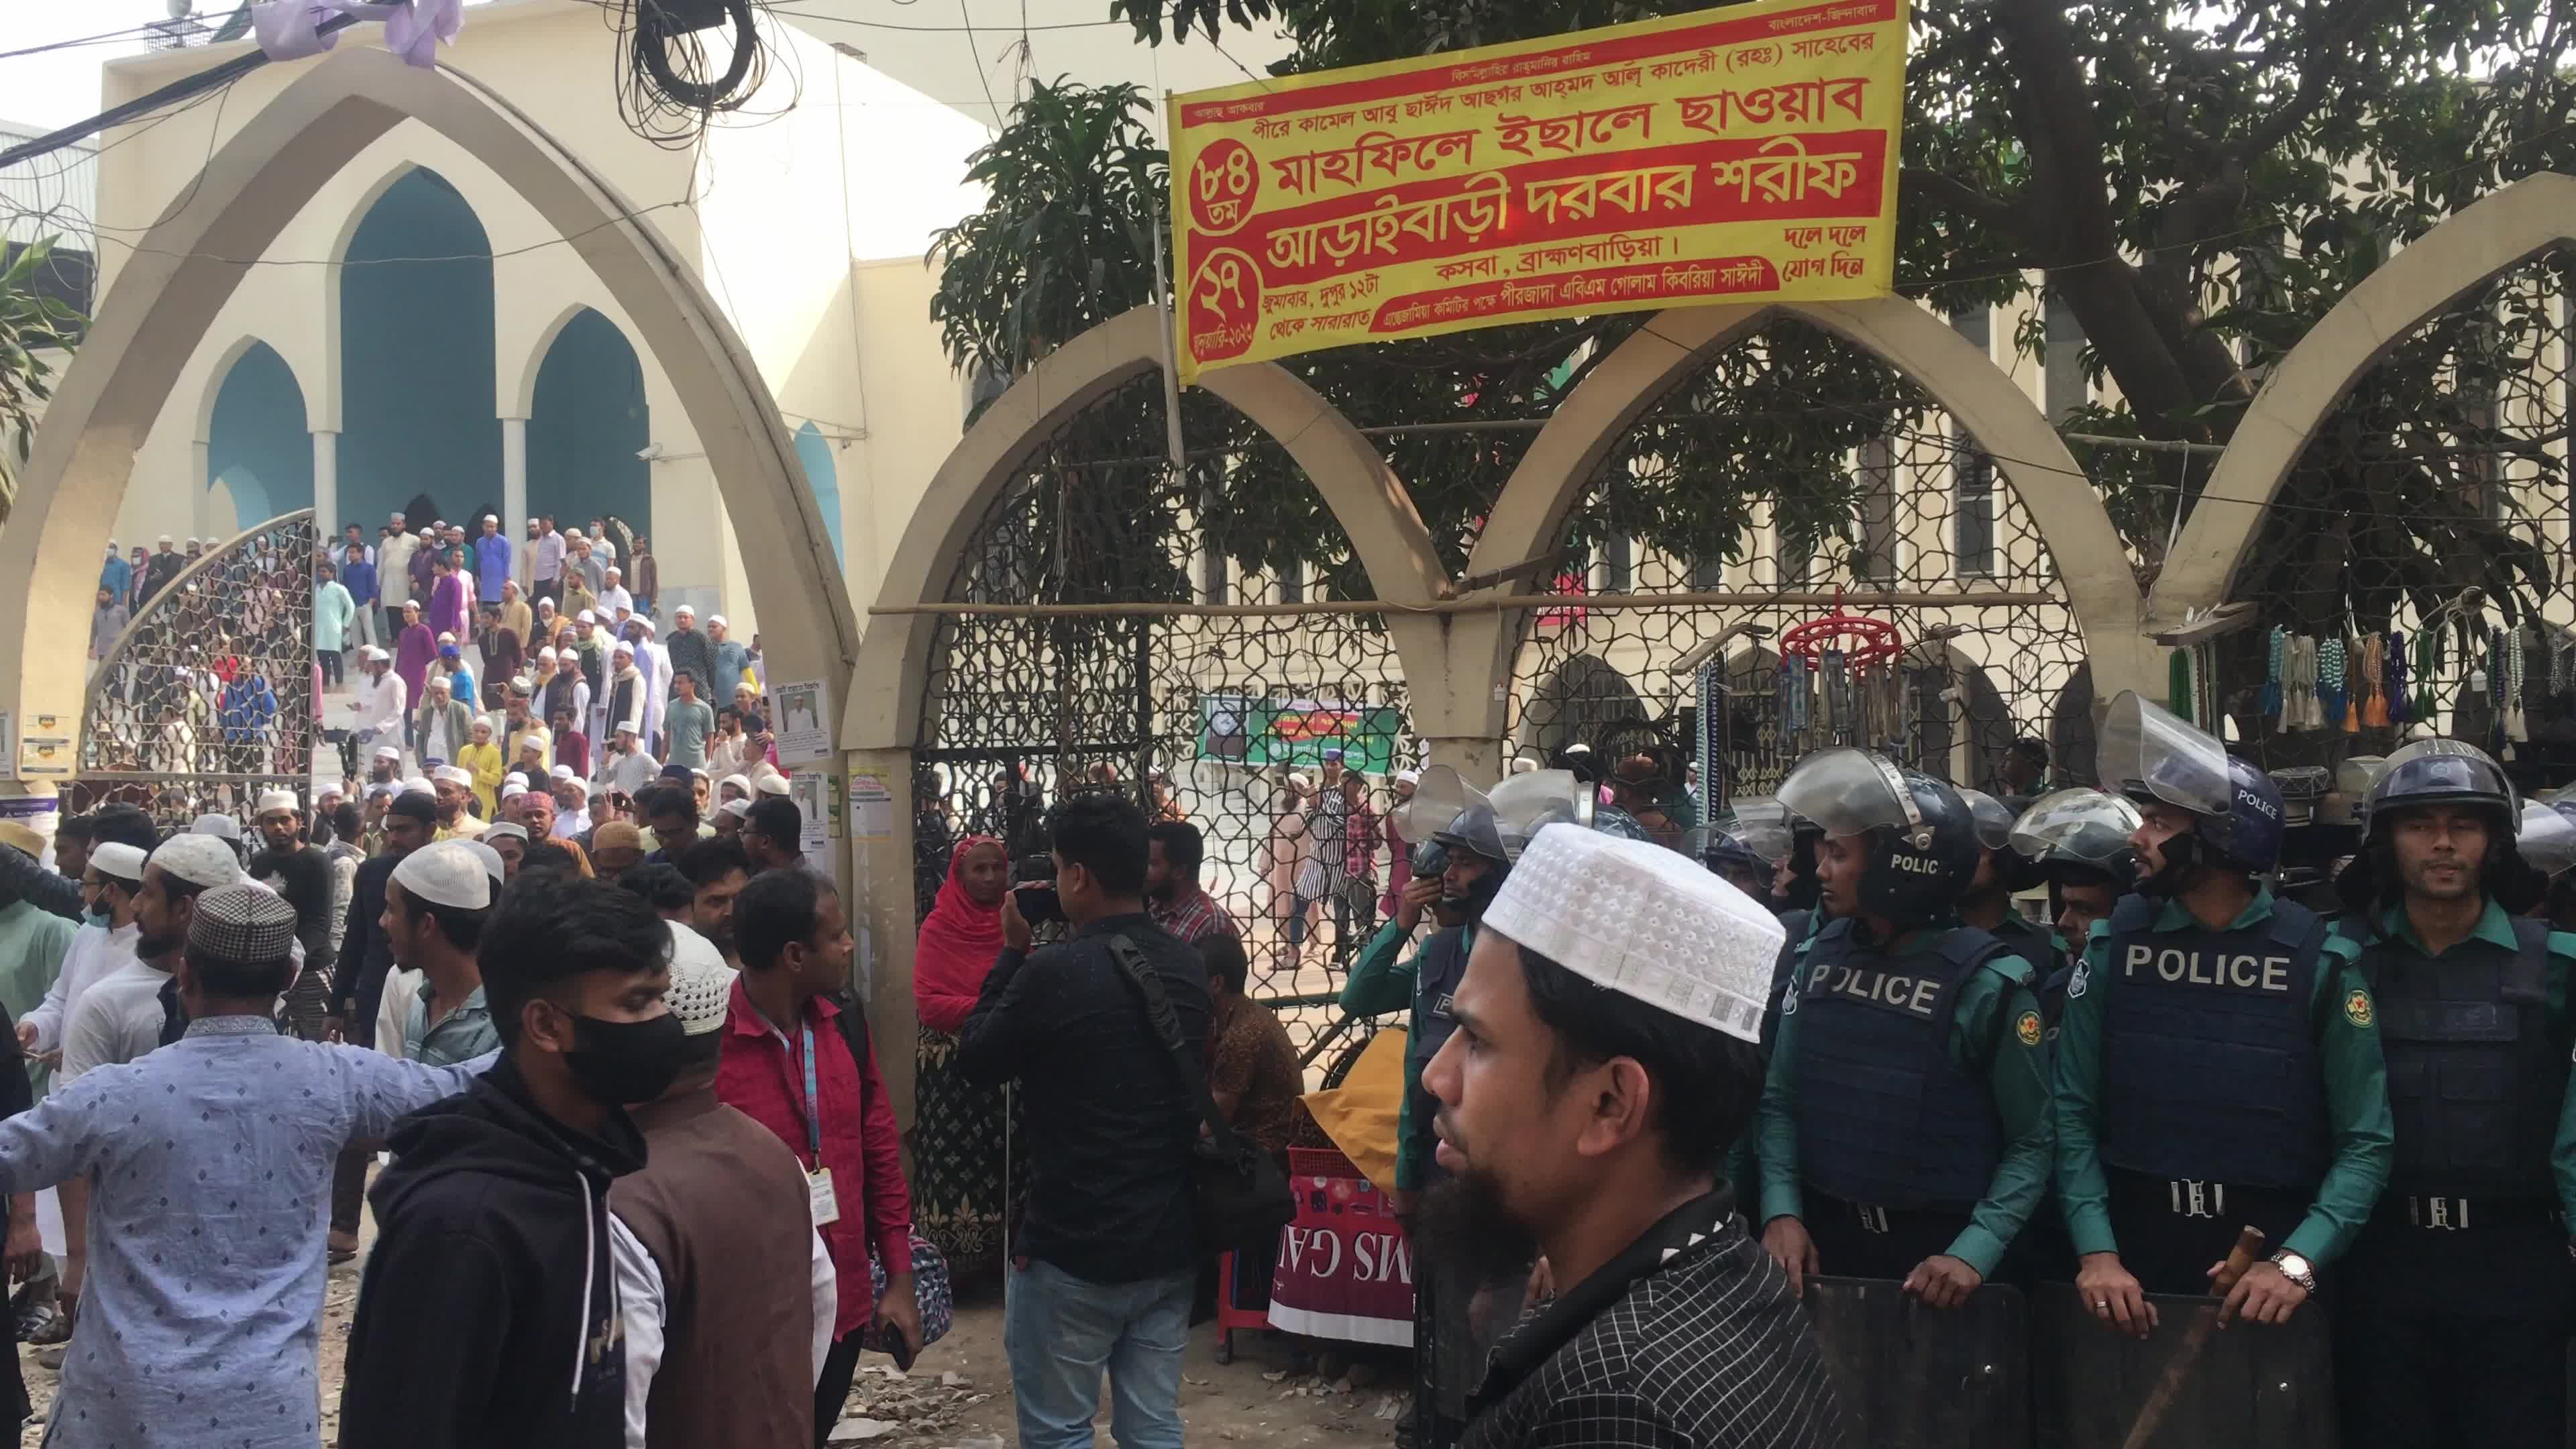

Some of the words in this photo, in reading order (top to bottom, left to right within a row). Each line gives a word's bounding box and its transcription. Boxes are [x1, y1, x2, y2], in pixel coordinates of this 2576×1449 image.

[1252, 118, 1293, 140] পীরে
[1298, 111, 1356, 133] কামেল
[1361, 104, 1399, 124] আবু
[1650, 50, 1719, 78] কাদেরী
[1791, 32, 1876, 58] সাহেবের
[1269, 129, 1481, 196] মাহফিলে
[1493, 102, 1660, 157] ইছালে
[1674, 76, 1872, 134] ছাওয়াব
[1197, 148, 1250, 202] ৮৪
[1205, 197, 1242, 226] তম
[1267, 170, 1512, 269] আড়াইবাড়ী
[1525, 164, 1697, 226] দরবার
[1711, 136, 1864, 204] শরীফ
[1784, 225, 1823, 249] দলে
[1828, 225, 1868, 248] দলে
[1434, 295, 1470, 317] কমিটির
[1472, 294, 1498, 312] পক্ষে
[1499, 282, 1556, 307] পীরজাদা
[1560, 274, 1607, 302] এবিএম
[1610, 271, 1656, 297] গোলাম
[1662, 264, 1717, 291] কিবরিয়া
[1721, 259, 1765, 287] সাঈদী
[1782, 256, 1826, 282] যোগ
[1831, 251, 1864, 278] দিন
[1200, 260, 1246, 323] ২৭
[1320, 282, 1346, 308] দুপুর
[1349, 273, 1380, 300] ১২টা
[1269, 318, 1308, 340] থেকে
[1310, 309, 1371, 333] সারারাত
[2237, 789, 2279, 820] POLICE
[2125, 945, 2291, 991] POLICE
